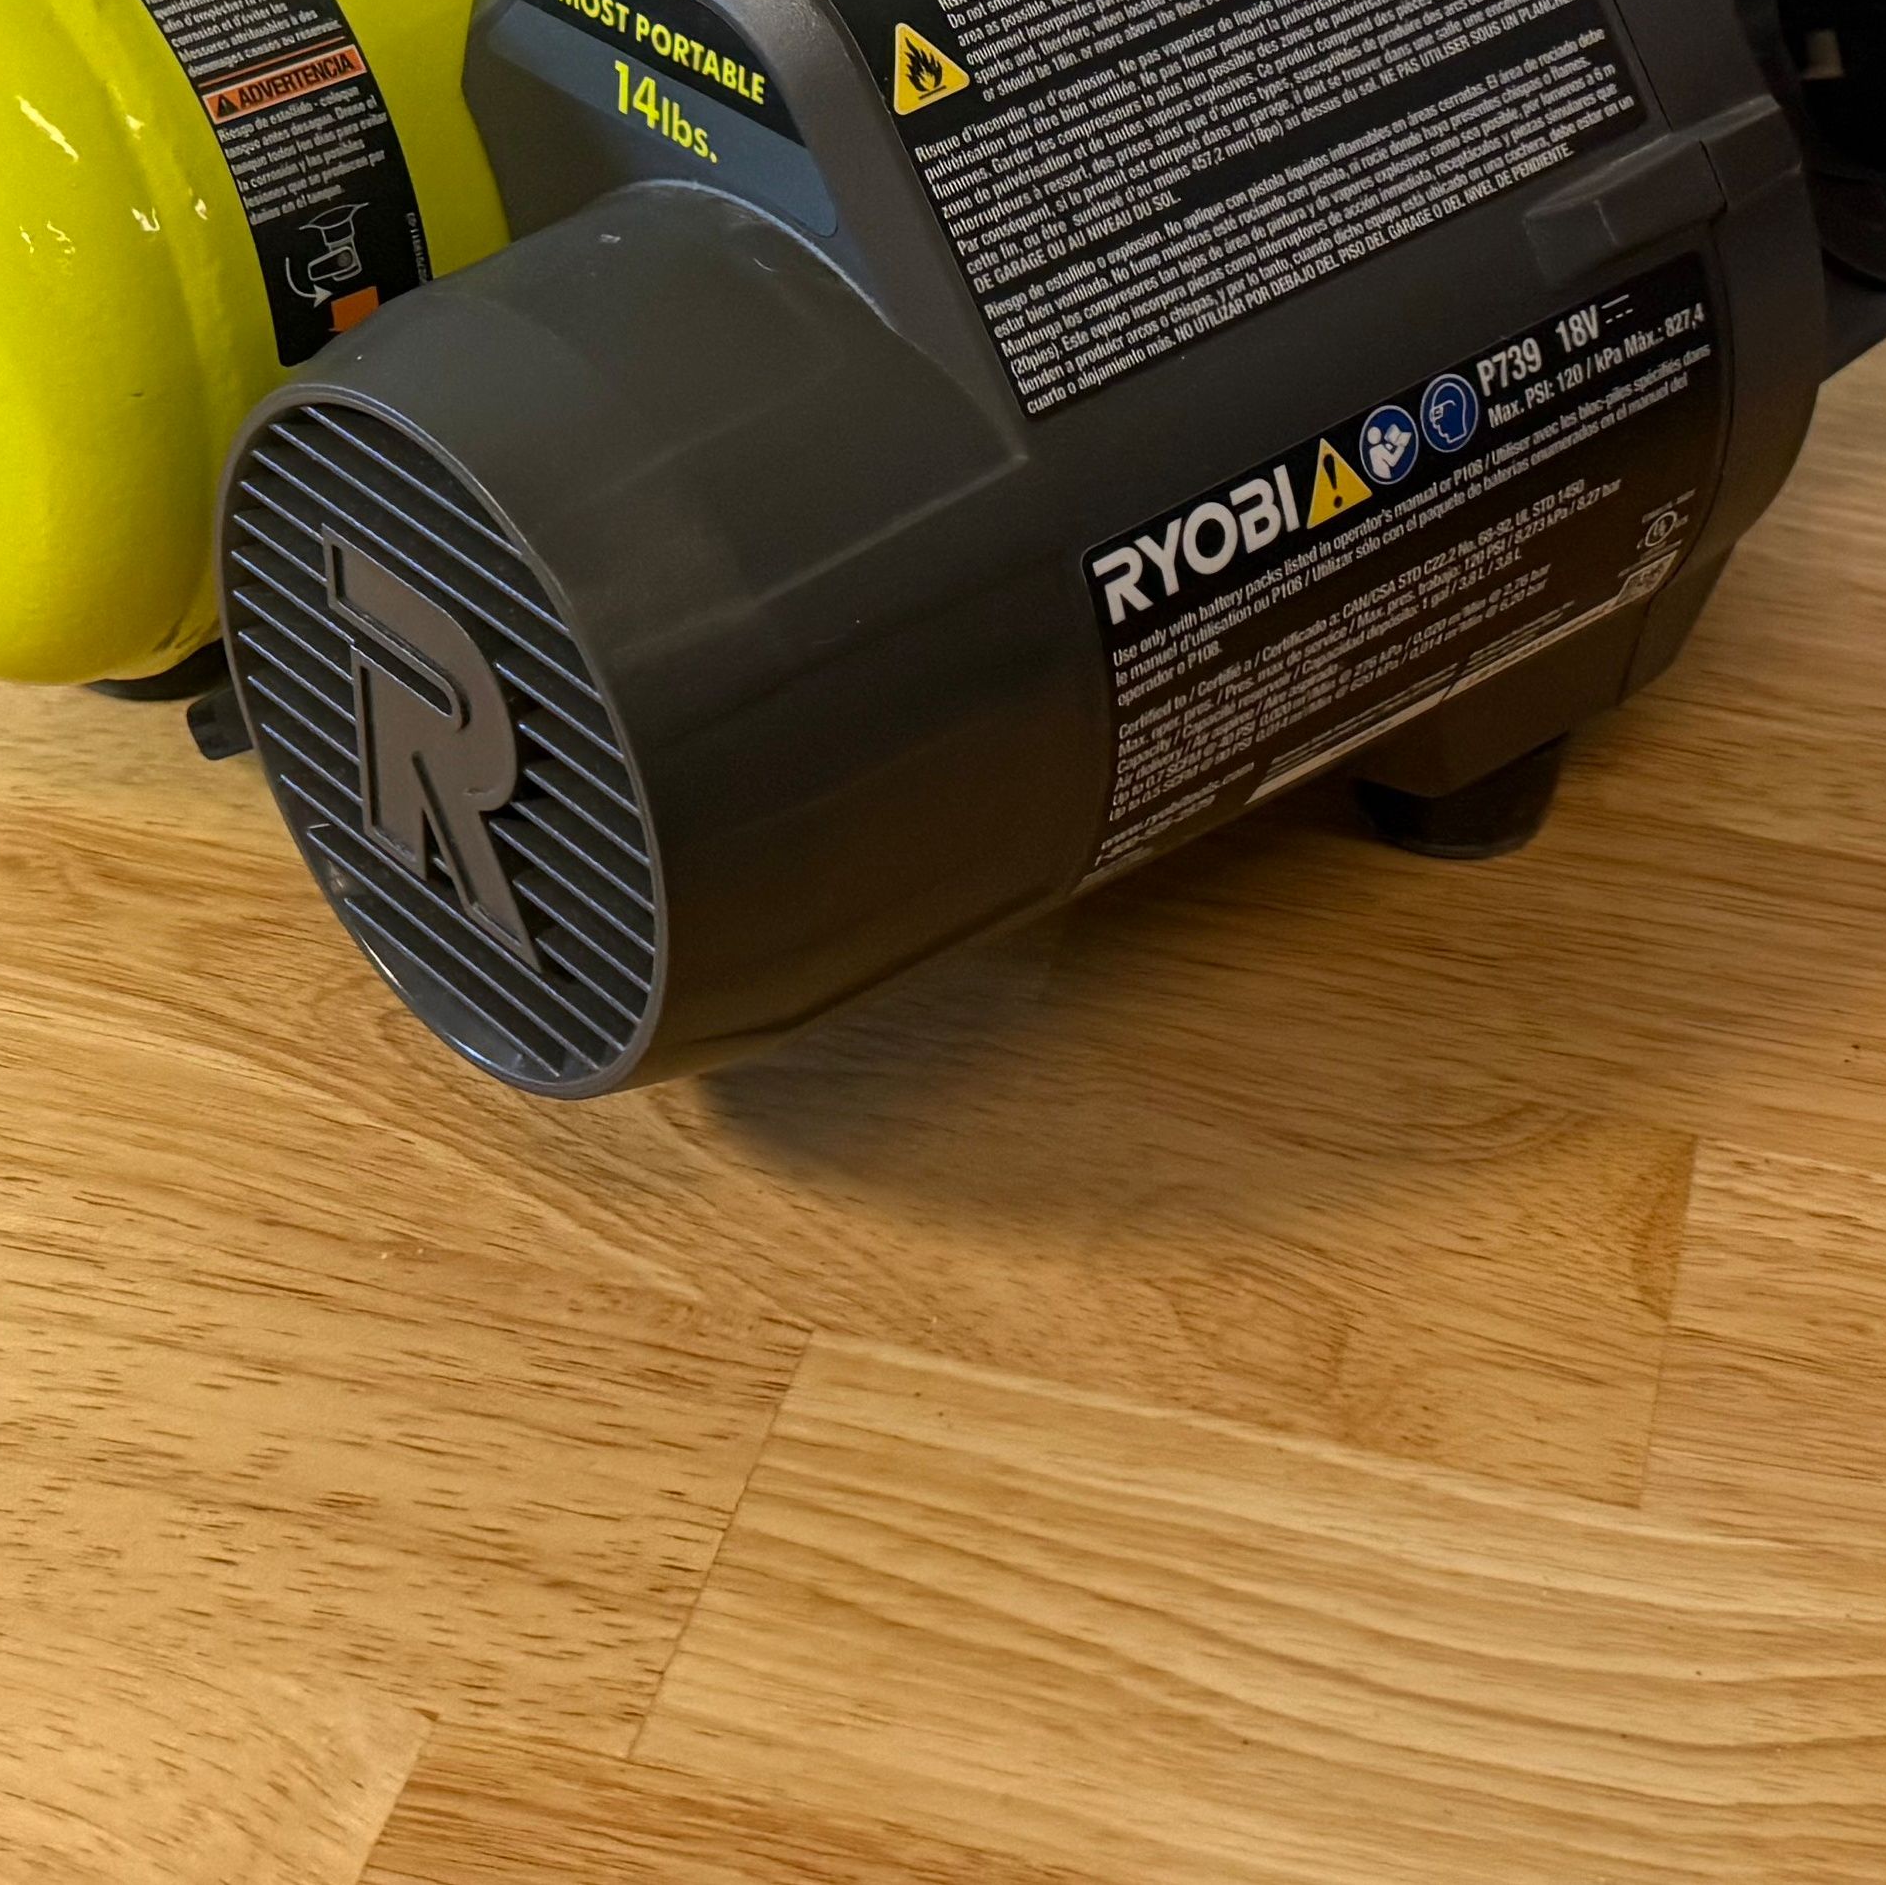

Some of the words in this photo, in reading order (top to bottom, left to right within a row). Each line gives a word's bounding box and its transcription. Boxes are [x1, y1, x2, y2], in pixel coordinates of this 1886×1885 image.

[237, 53, 356, 108] ADVERTENCIA
[615, 59, 719, 164] 14lbs.
[636, 12, 766, 106] PORTABLE
[973, 272, 995, 294] DE
[993, 248, 1048, 284] GARAGE
[1046, 238, 1067, 260] OU
[1067, 229, 1087, 251] AU
[1085, 209, 1133, 242] NIVEAU
[1132, 200, 1153, 221] DU
[1151, 189, 1182, 211] SOL.
[1476, 337, 1542, 398] P739
[1555, 304, 1600, 354] 18V
[1487, 399, 1525, 429] Max.
[1524, 379, 1556, 410] PSI:
[1556, 364, 1584, 393] 120
[1595, 345, 1623, 374] kPa
[1665, 302, 1706, 339] 827,4
[1091, 464, 1301, 625] RYOBI
